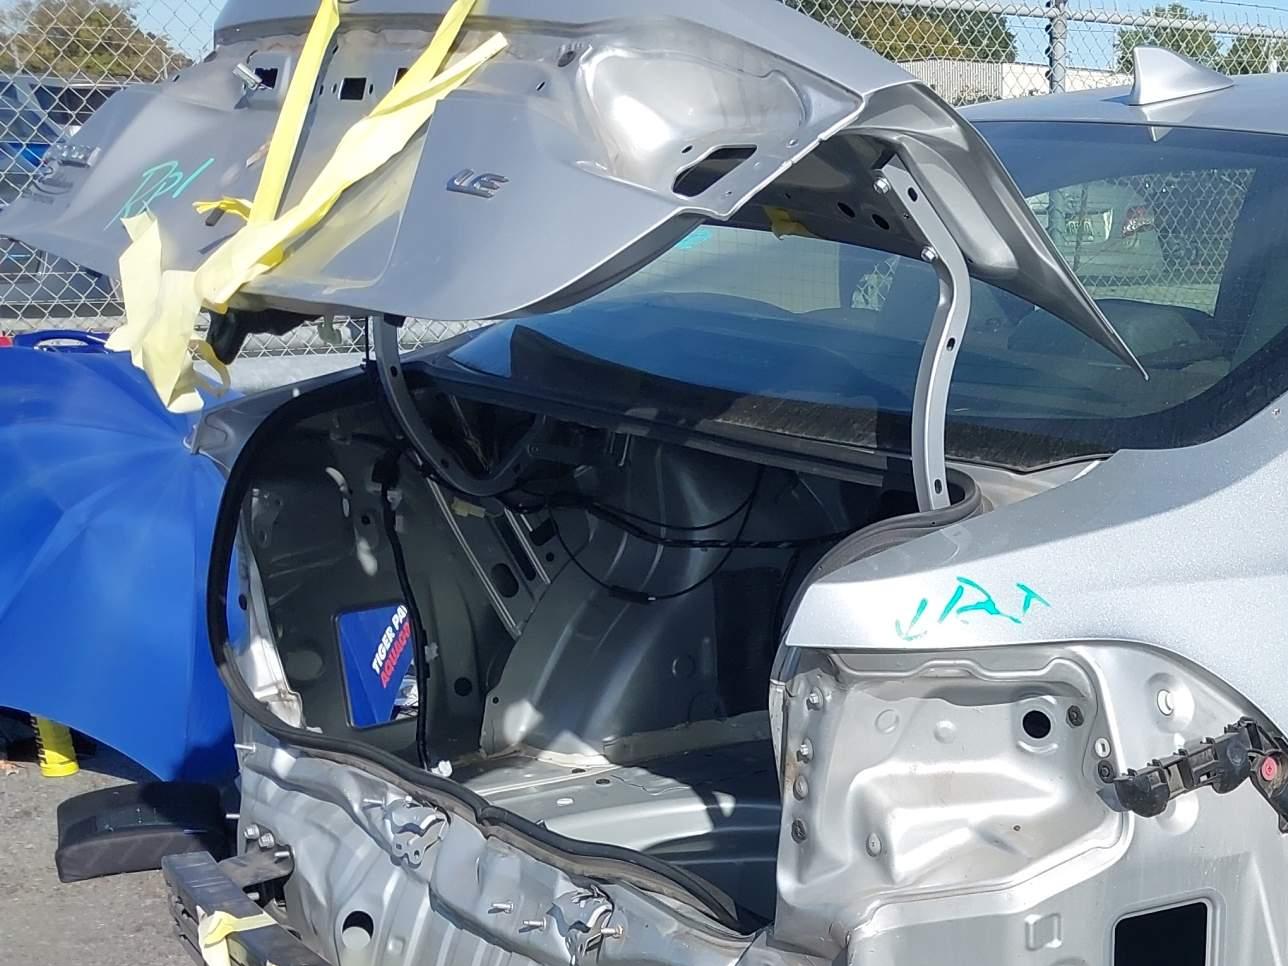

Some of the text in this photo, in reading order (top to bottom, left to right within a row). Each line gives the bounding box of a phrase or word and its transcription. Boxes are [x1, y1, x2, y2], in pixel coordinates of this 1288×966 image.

[446, 168, 510, 199] LE
[371, 605, 408, 675] TIGER PA
